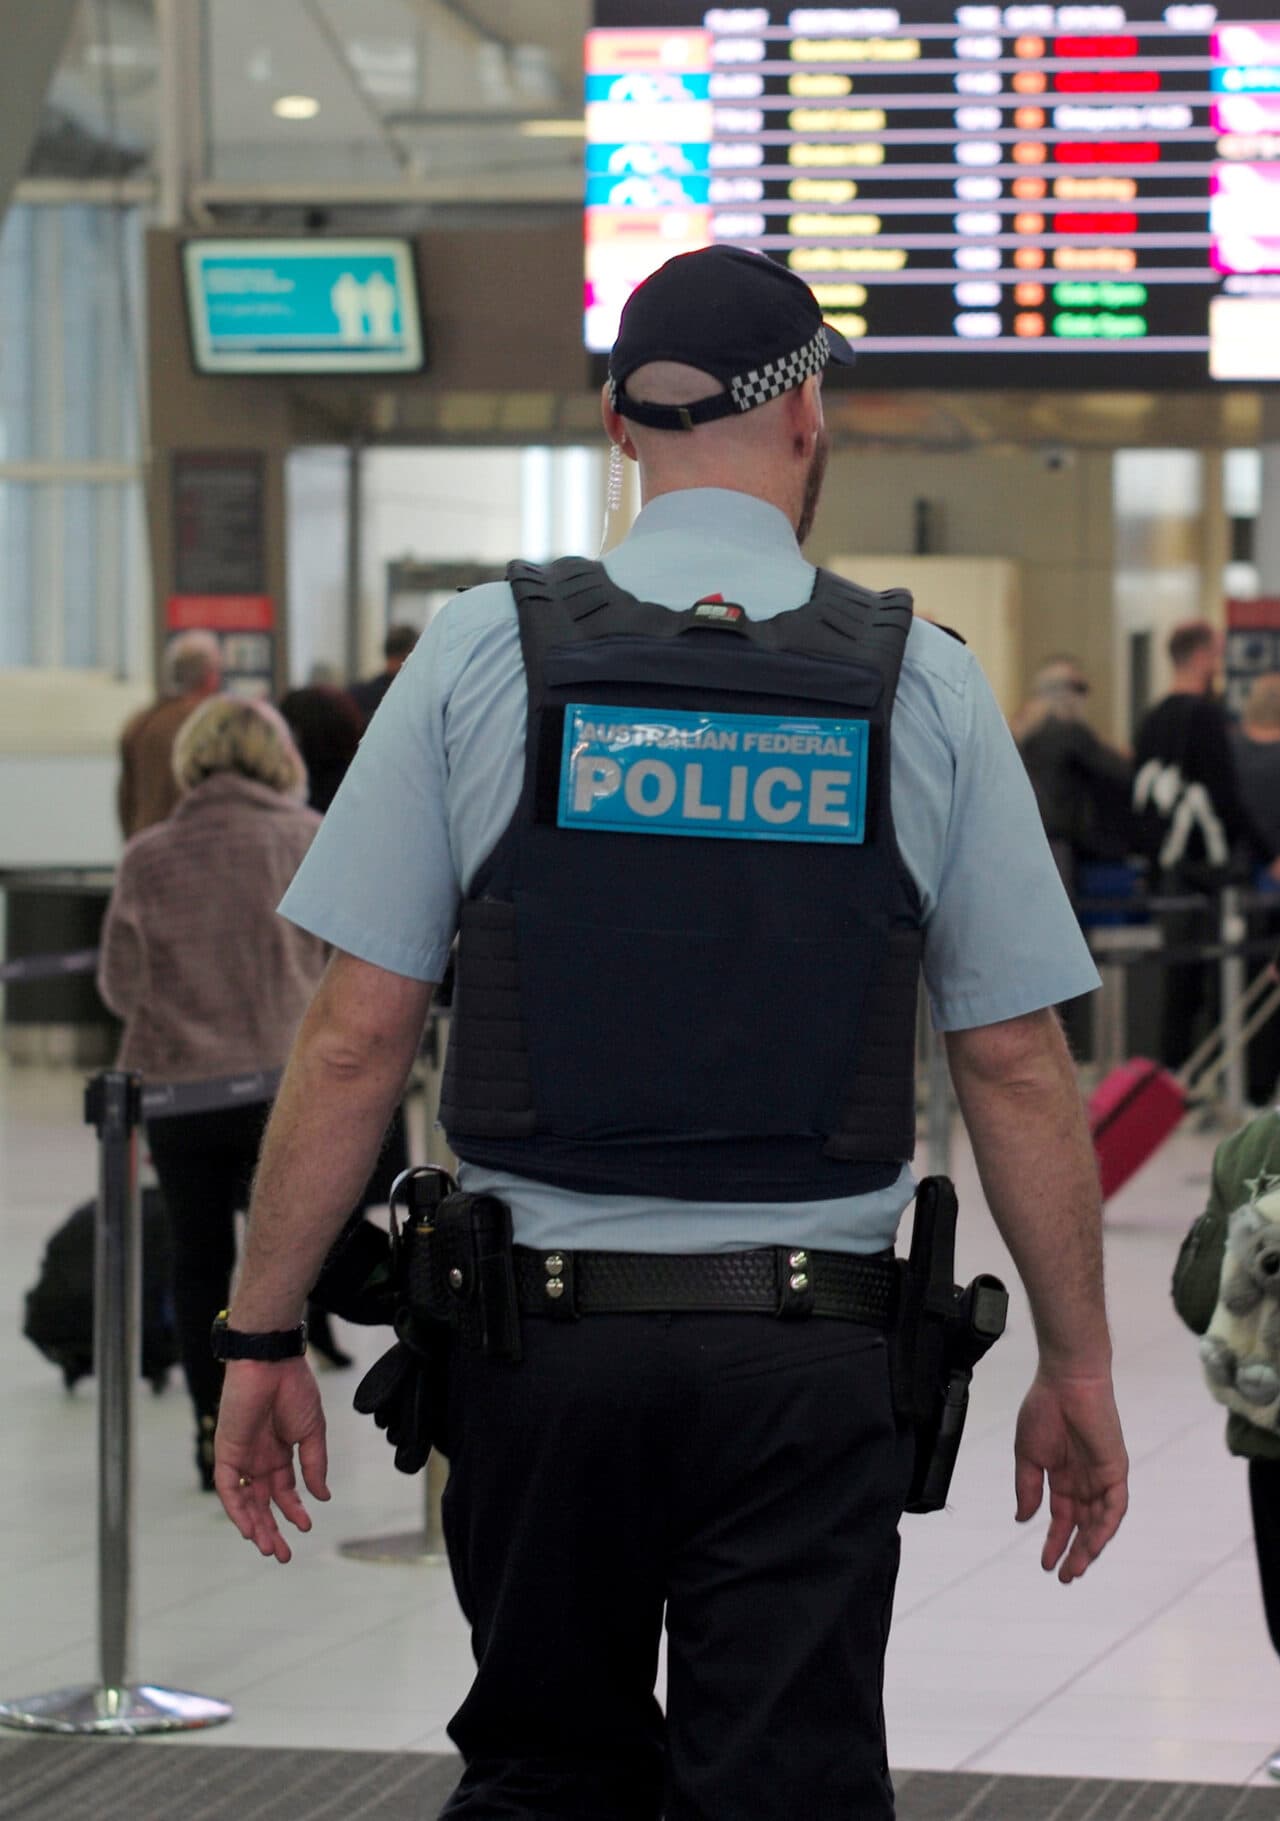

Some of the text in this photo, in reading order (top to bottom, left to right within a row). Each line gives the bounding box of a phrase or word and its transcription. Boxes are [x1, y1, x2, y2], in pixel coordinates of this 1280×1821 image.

[579, 723, 853, 757] AUSTRALIAN FEDERAL
[573, 755, 852, 828] POLICE
